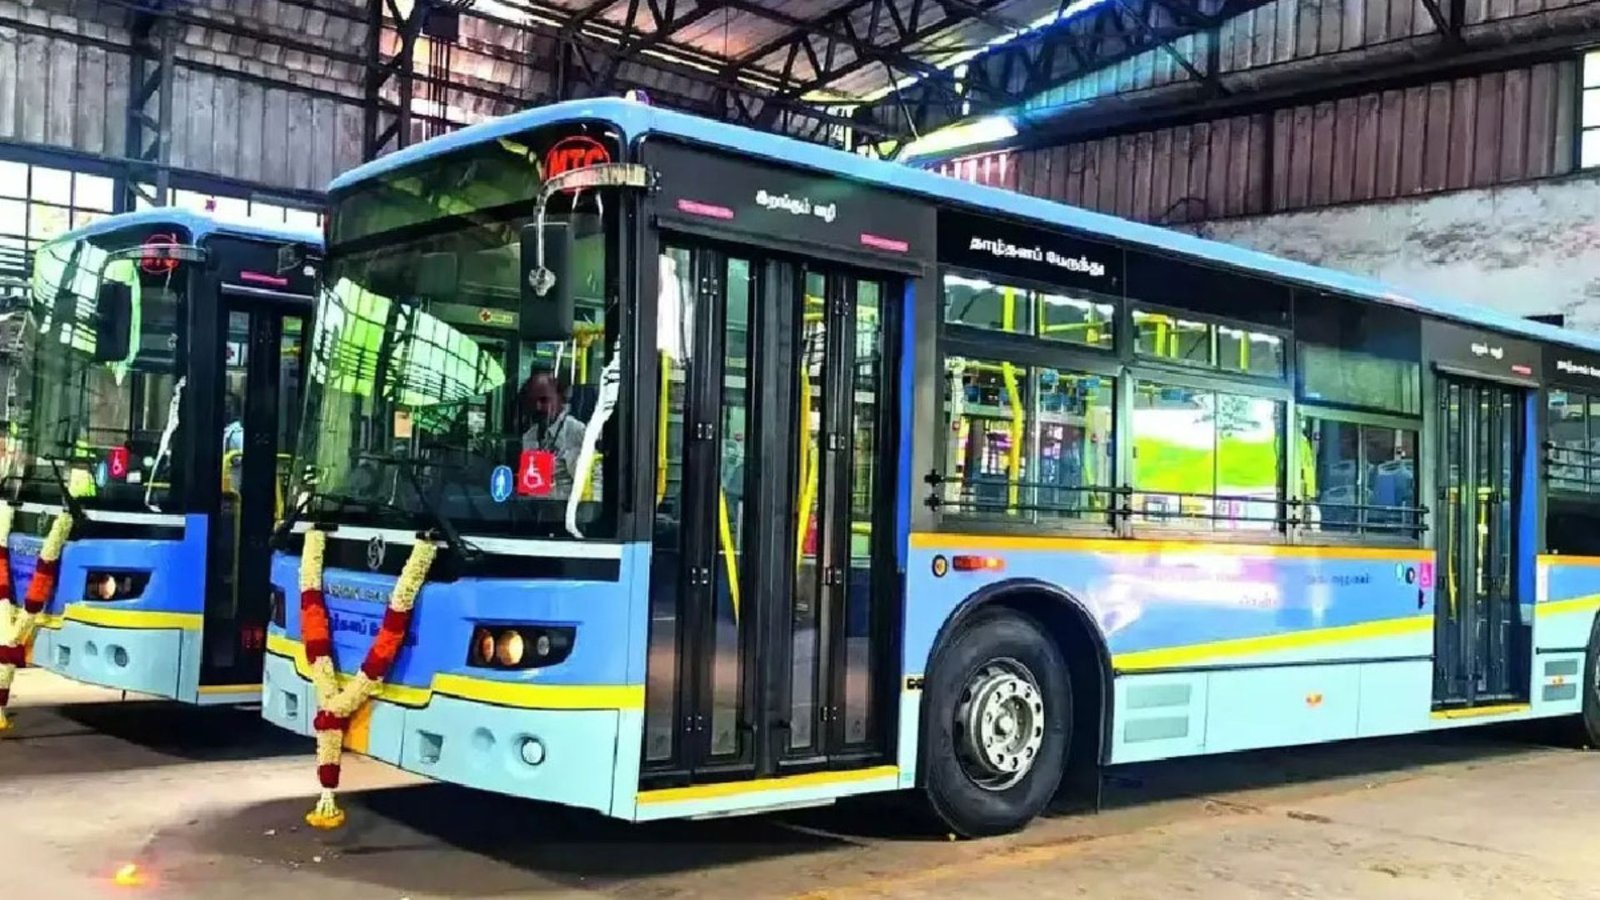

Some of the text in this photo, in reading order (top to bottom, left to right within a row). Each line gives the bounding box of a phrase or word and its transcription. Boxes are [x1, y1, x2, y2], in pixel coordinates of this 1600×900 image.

[549, 146, 604, 180] MTC
[813, 203, 836, 223] வழி
[1046, 251, 1105, 277] பேருந்து
